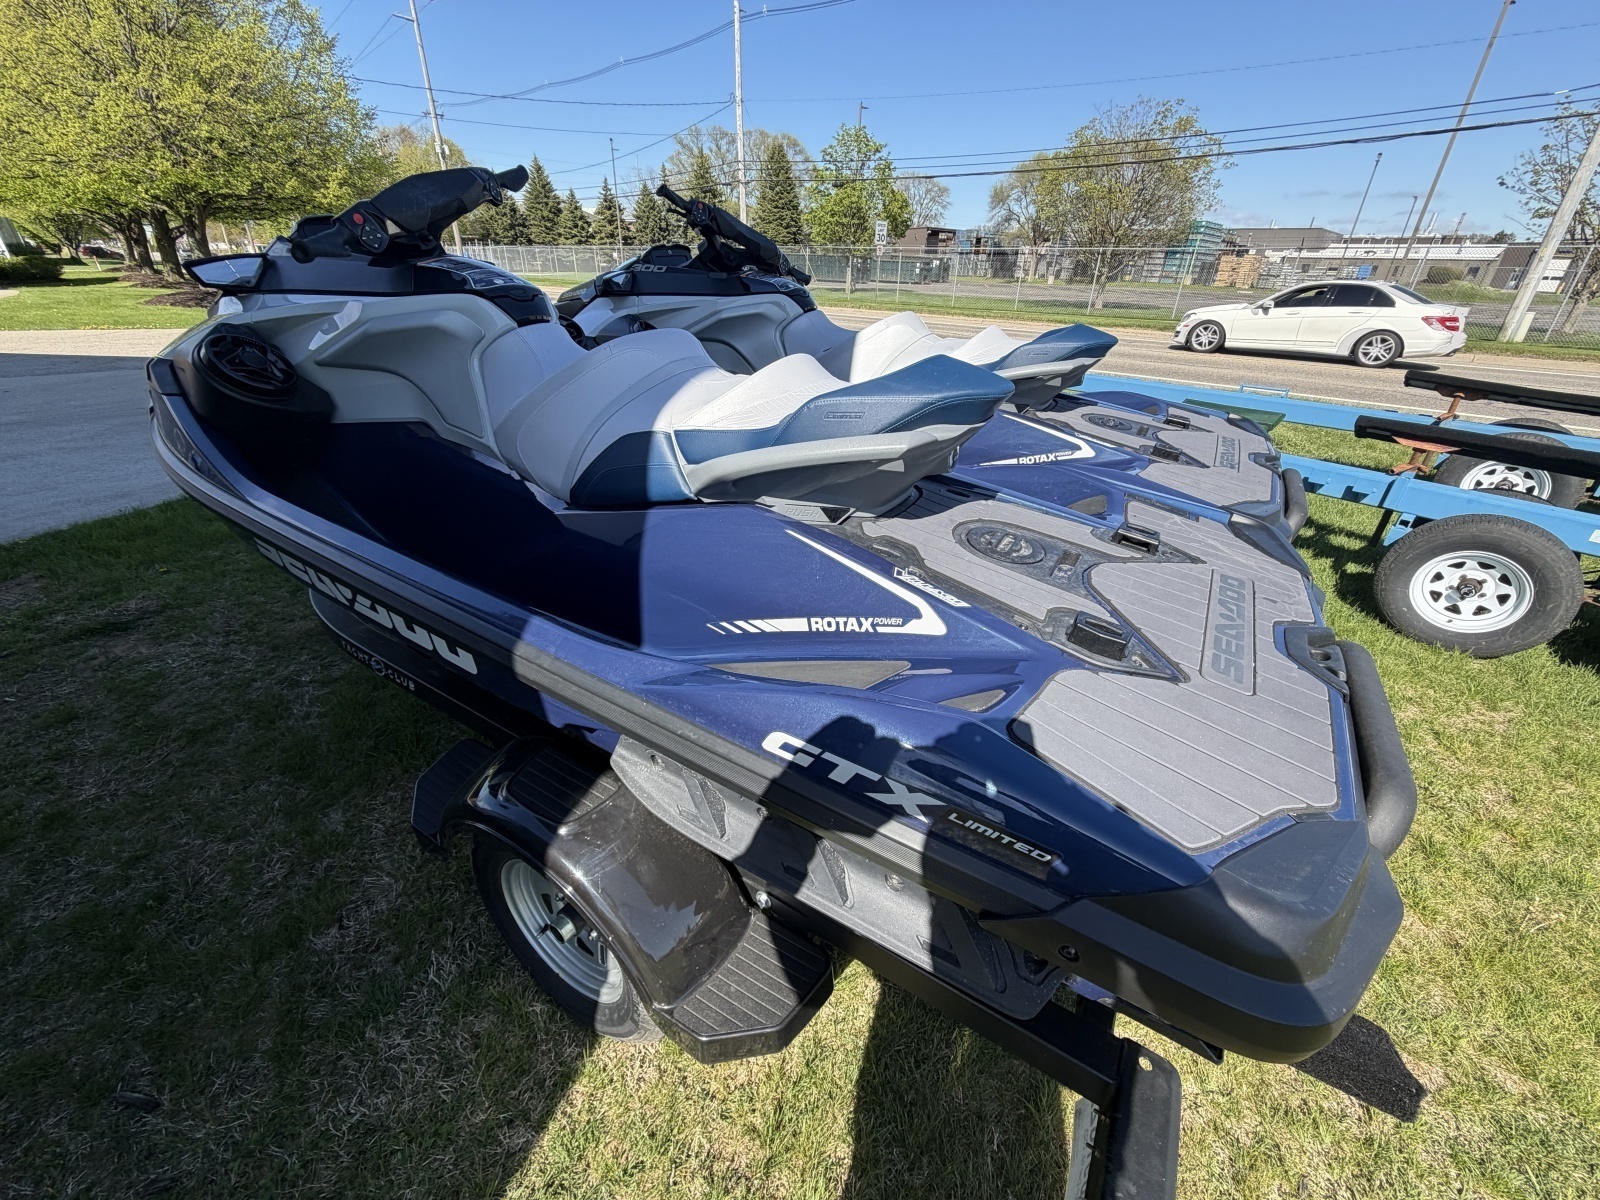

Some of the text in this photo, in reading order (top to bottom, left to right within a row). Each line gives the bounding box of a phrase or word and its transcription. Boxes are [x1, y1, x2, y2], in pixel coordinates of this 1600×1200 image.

[876, 233, 885, 242] 30
[630, 264, 667, 273] 300
[1019, 452, 1057, 465] ROTAX
[784, 507, 821, 518] PUSH
[810, 617, 903, 632] ROTAX POWER
[341, 640, 416, 691] YACHT CLUB
[947, 812, 1052, 862] LIMITED
